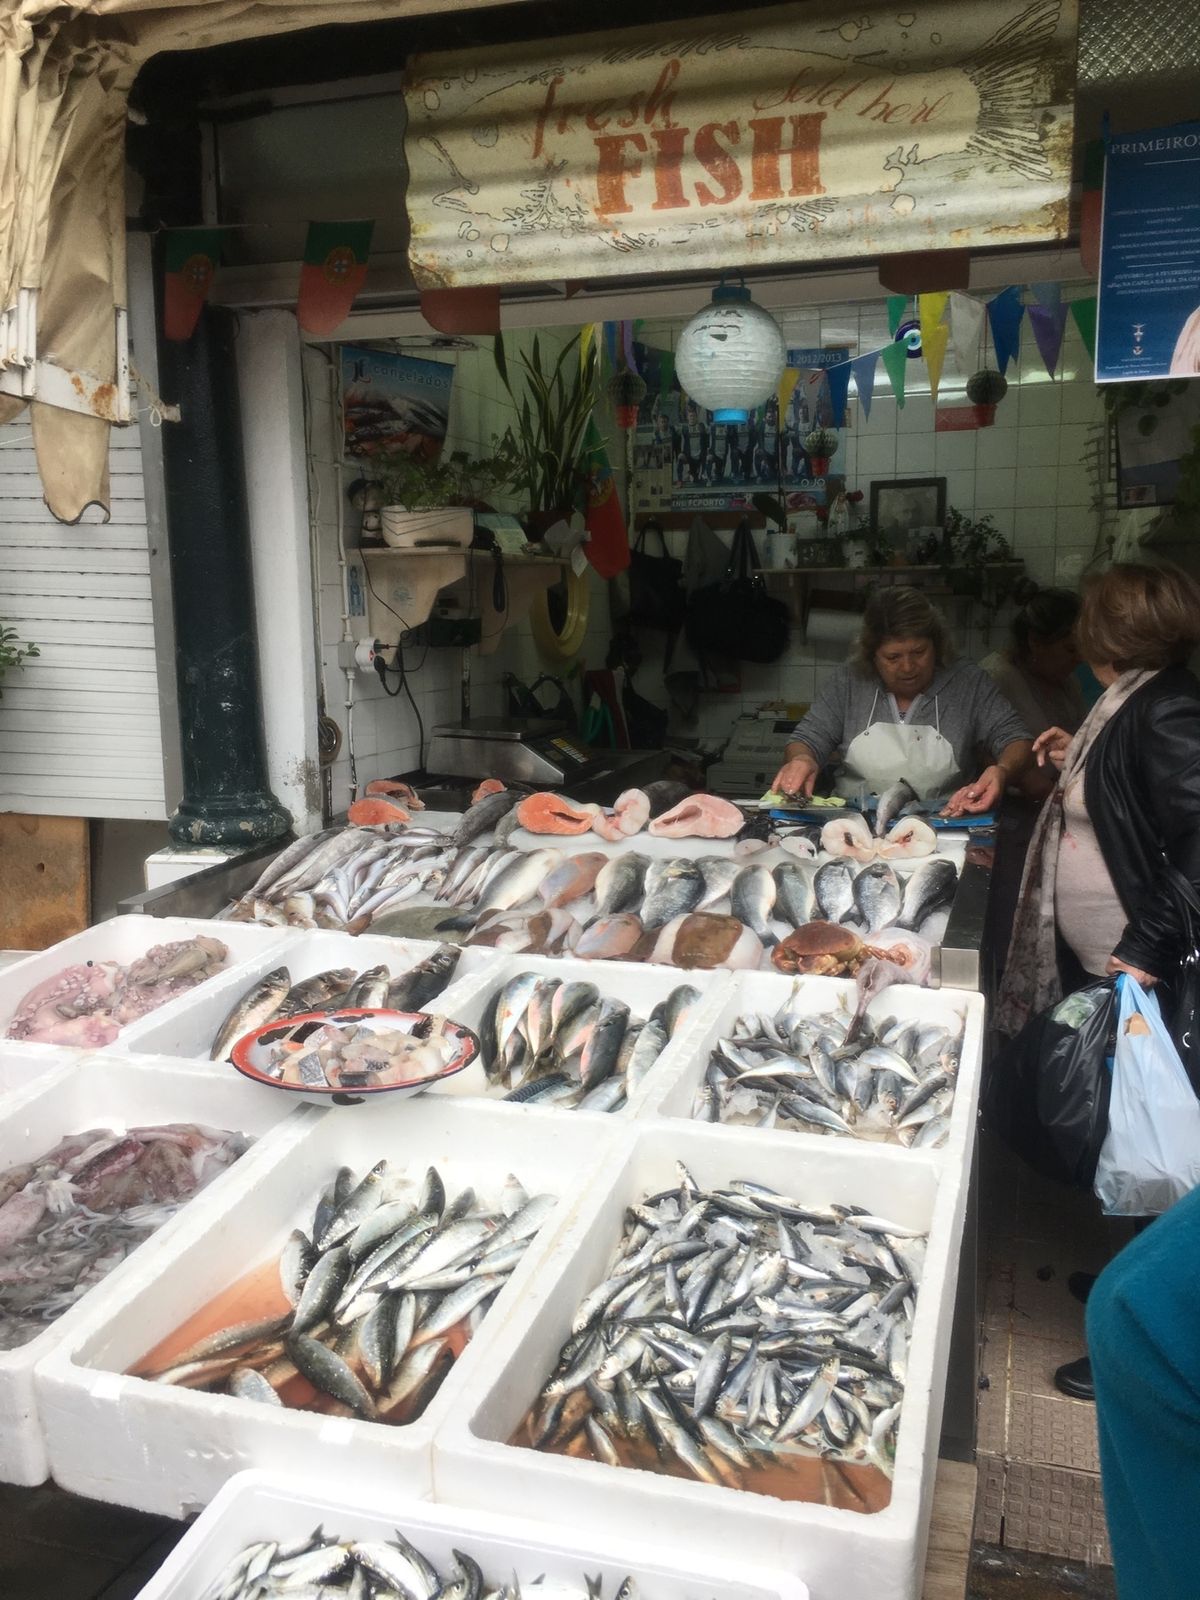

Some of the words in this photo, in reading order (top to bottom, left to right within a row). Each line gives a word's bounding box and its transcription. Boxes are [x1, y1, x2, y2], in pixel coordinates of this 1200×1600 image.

[532, 58, 681, 160] fresh
[1111, 134, 1200, 154] PRIMEIRO
[594, 112, 828, 215] FISH
[796, 353, 842, 365] 2012/2013
[374, 365, 449, 388] congelados
